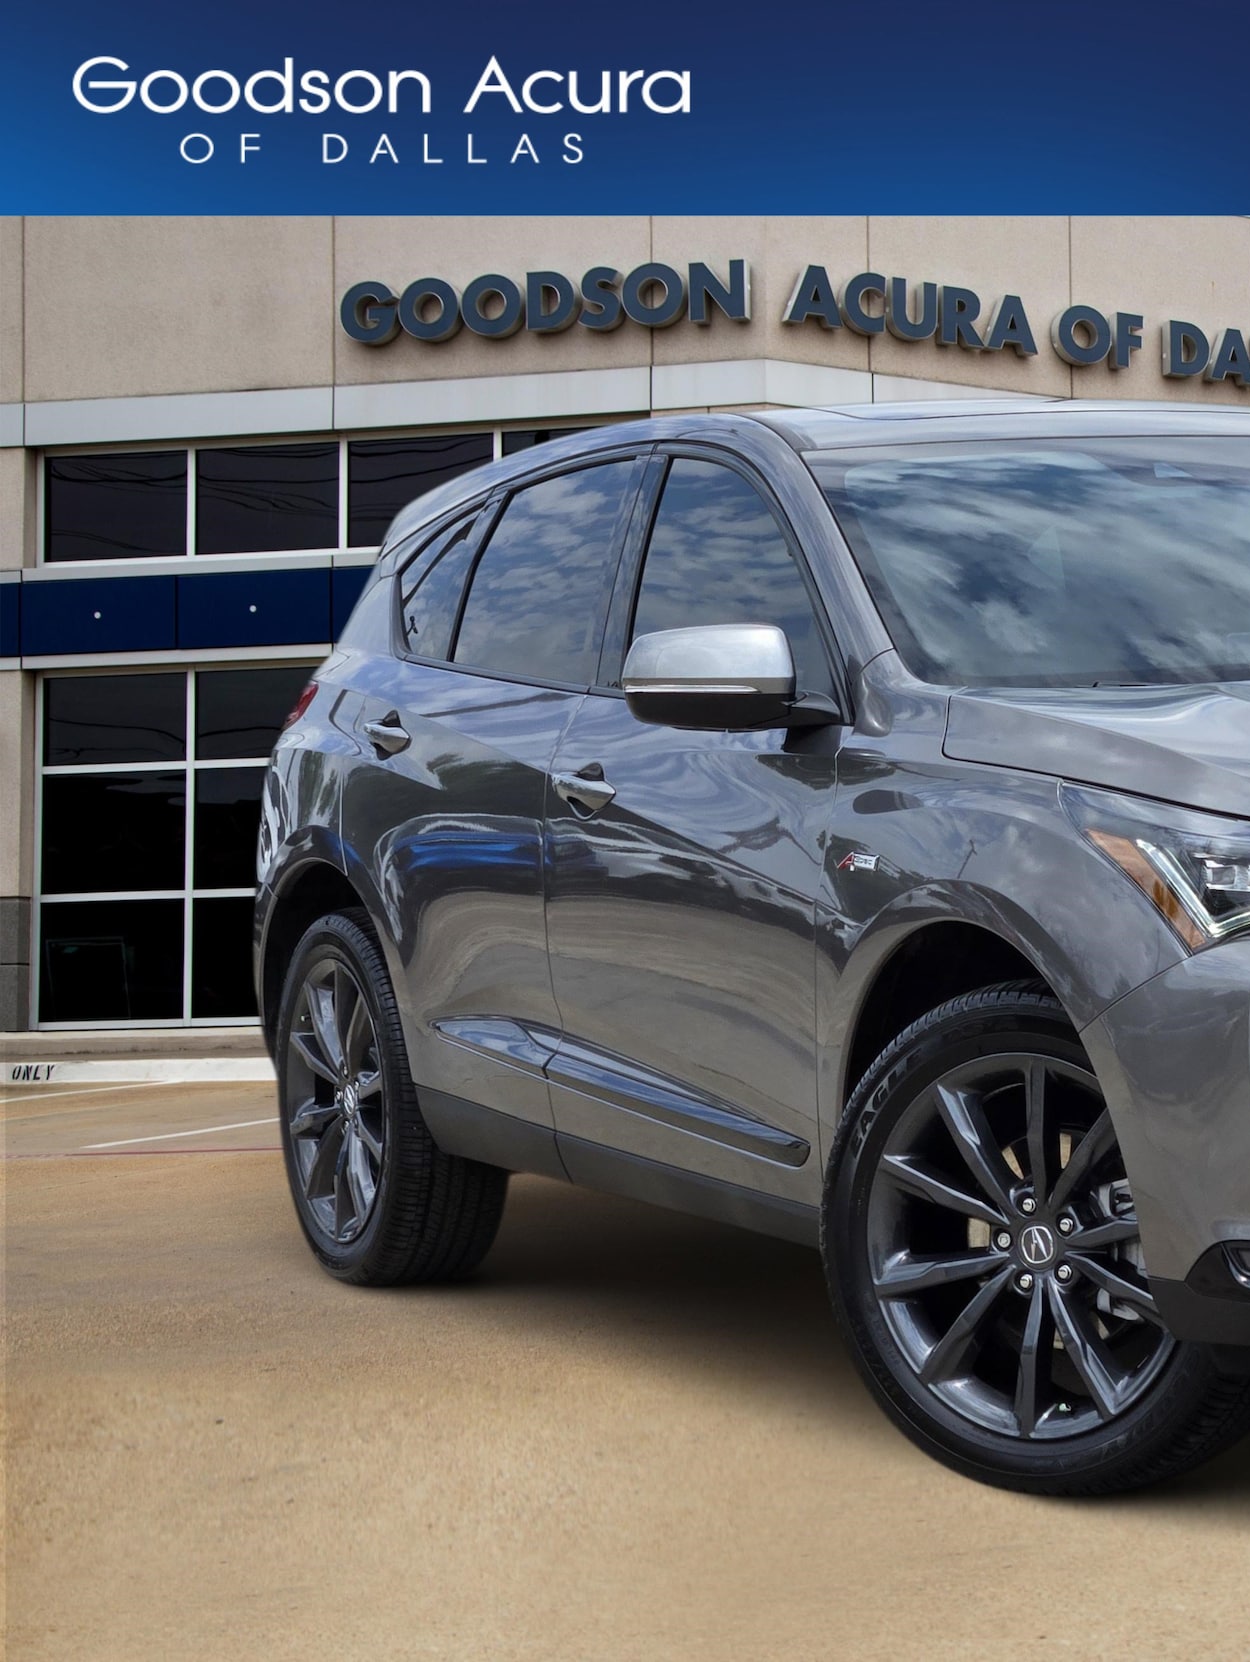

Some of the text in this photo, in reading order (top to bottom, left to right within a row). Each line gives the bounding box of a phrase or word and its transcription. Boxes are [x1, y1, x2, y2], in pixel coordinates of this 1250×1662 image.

[340, 259, 751, 346] GOODSON
[783, 265, 1037, 357] ACURA
[1051, 305, 1144, 370] OF
[11, 1064, 55, 1080] ONLY
